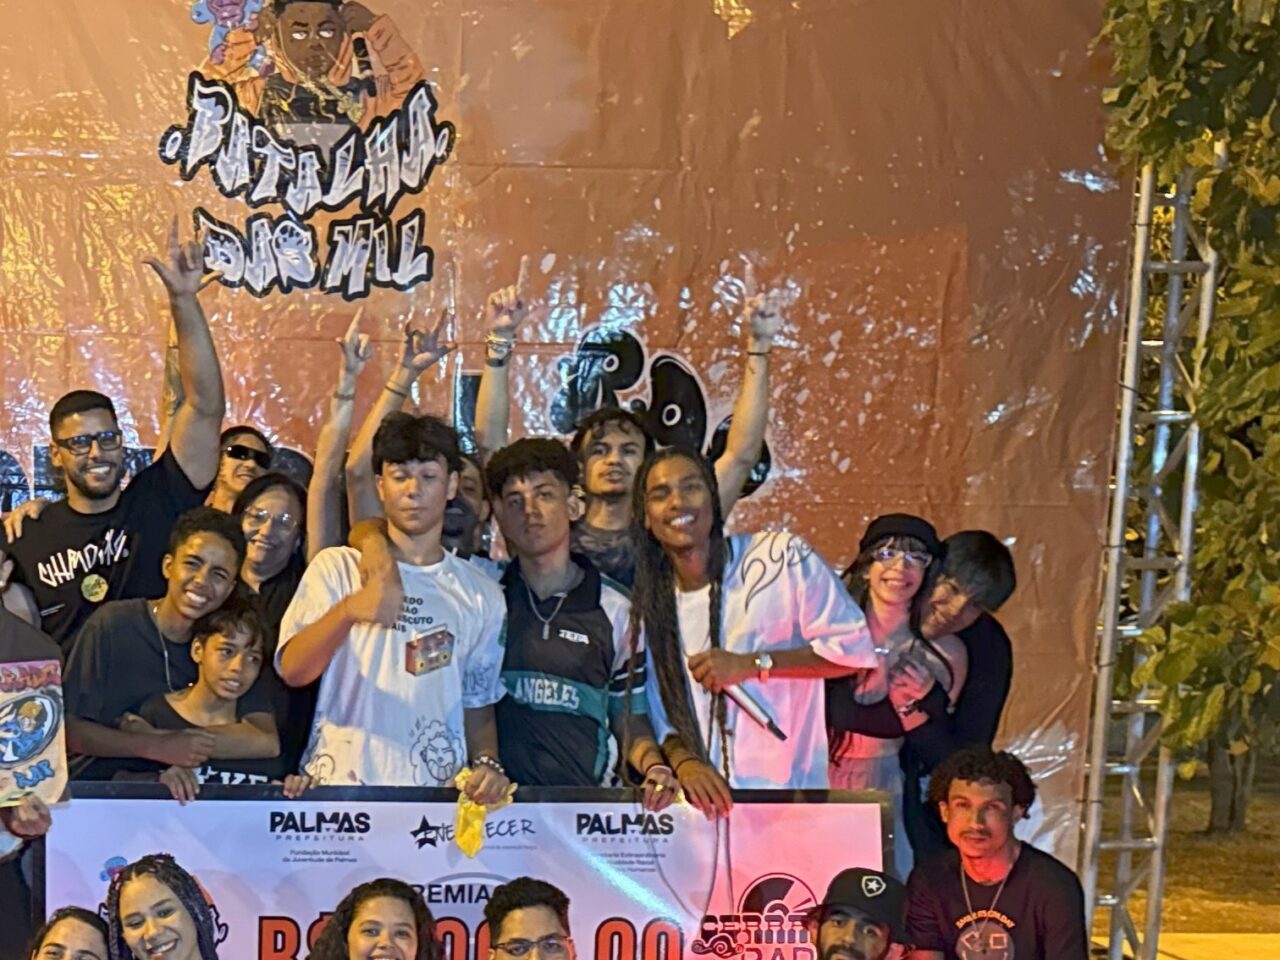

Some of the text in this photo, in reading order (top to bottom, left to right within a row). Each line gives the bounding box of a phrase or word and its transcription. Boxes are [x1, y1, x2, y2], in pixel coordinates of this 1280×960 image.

[324, 207, 434, 300] MIL
[269, 811, 371, 834] PALMAS
[424, 818, 537, 842] ENEECER
[576, 813, 674, 836] PALMAS
